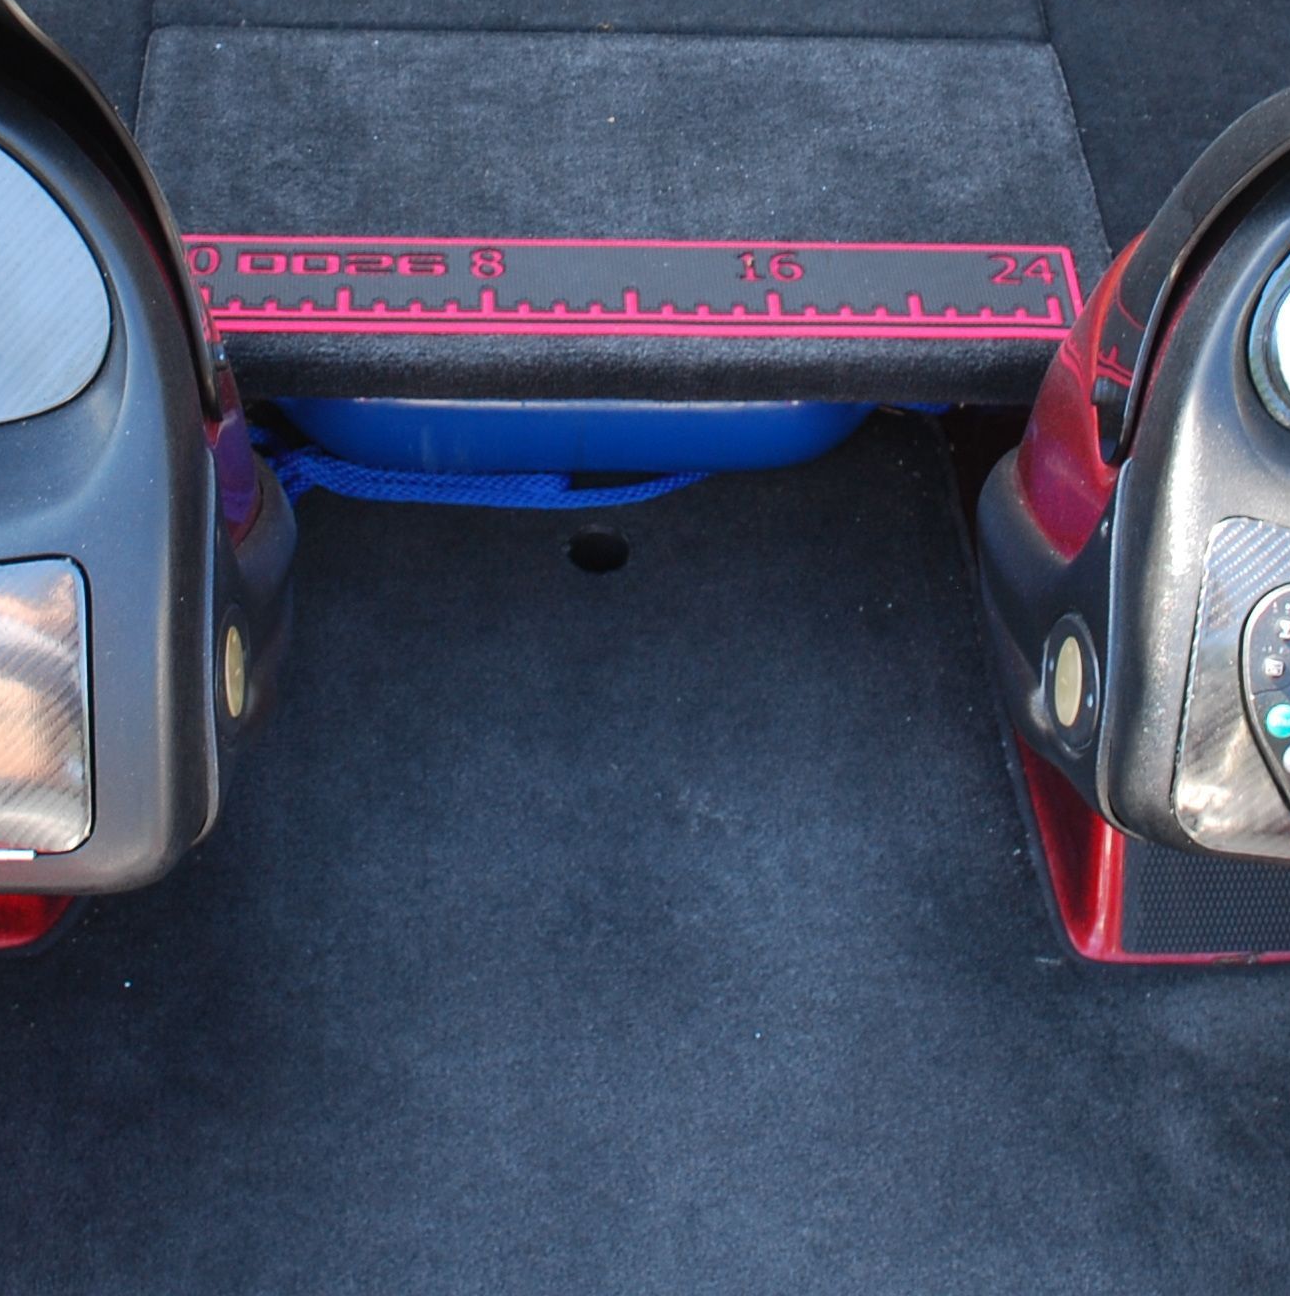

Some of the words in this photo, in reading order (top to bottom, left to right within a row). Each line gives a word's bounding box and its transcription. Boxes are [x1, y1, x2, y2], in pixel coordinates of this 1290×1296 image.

[189, 245, 221, 277] 0
[470, 248, 506, 279] 8
[737, 251, 805, 283] 16
[989, 254, 1056, 286] 24
